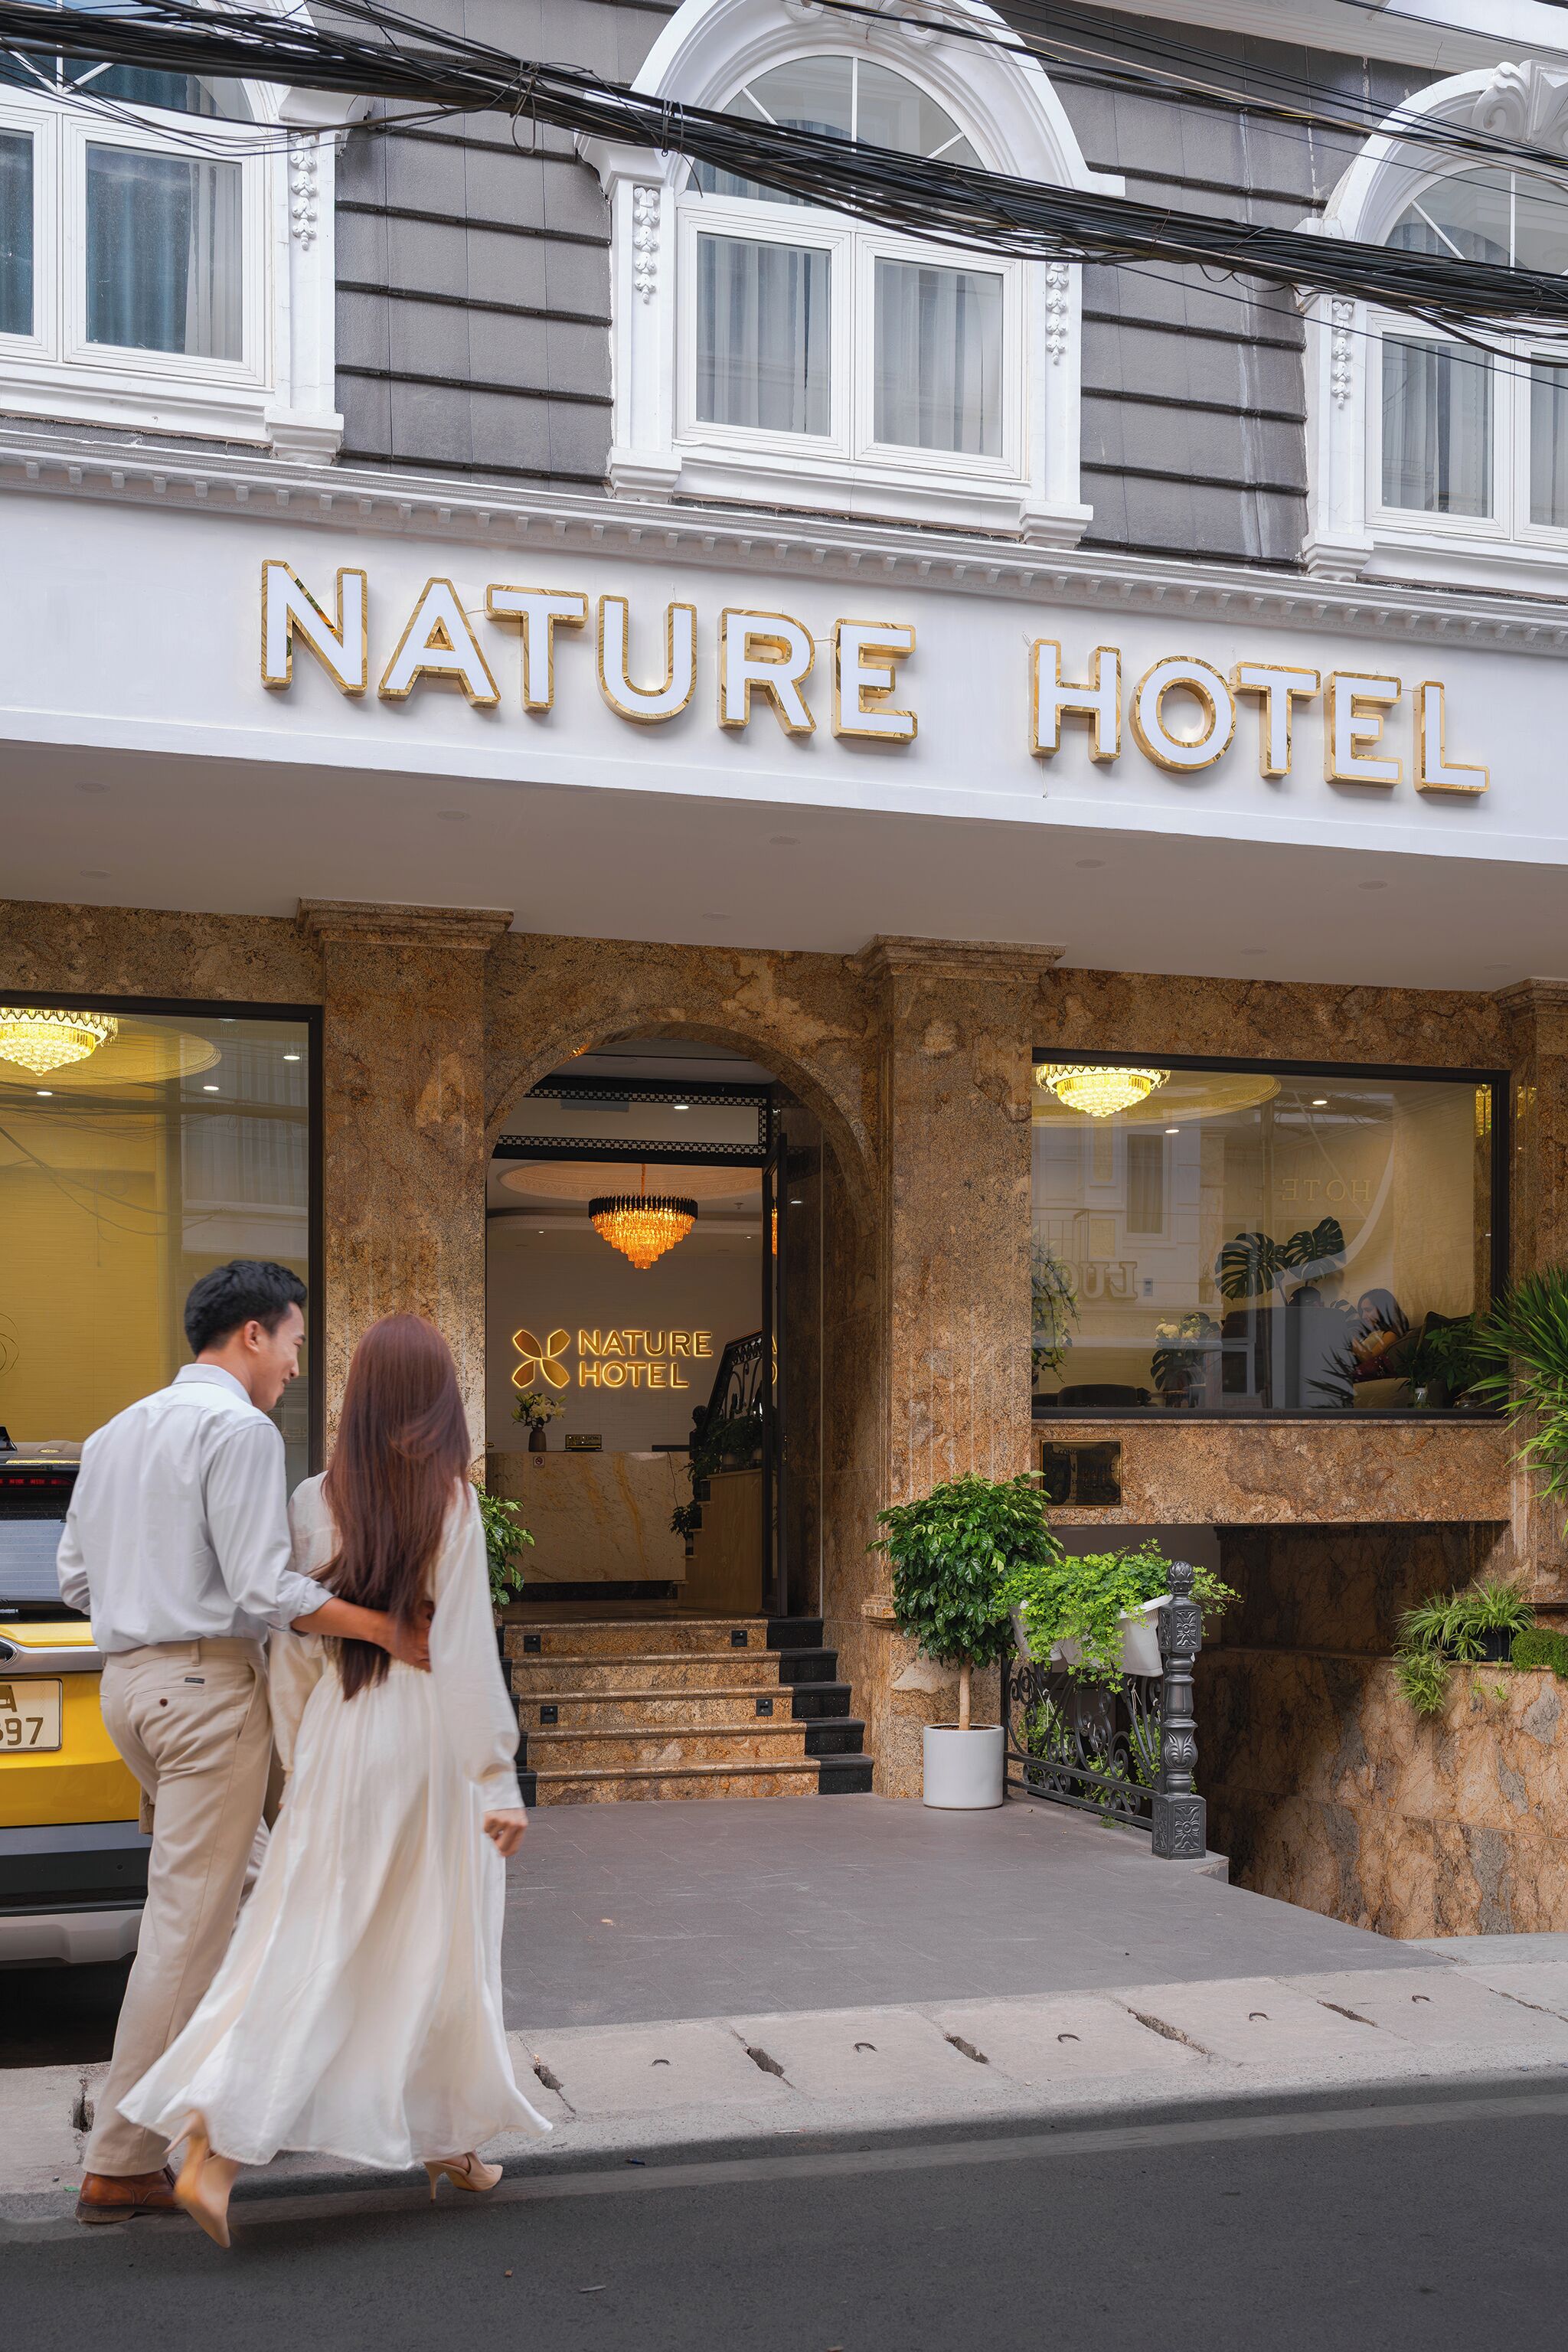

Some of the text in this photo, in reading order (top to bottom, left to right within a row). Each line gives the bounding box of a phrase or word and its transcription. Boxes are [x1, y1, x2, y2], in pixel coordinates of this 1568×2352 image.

[260, 559, 1490, 796] NATURE HOTEL
[578, 1329, 713, 1357] NATURE
[578, 1361, 689, 1388] HOTEL
[0, 1717, 44, 1746] 97
